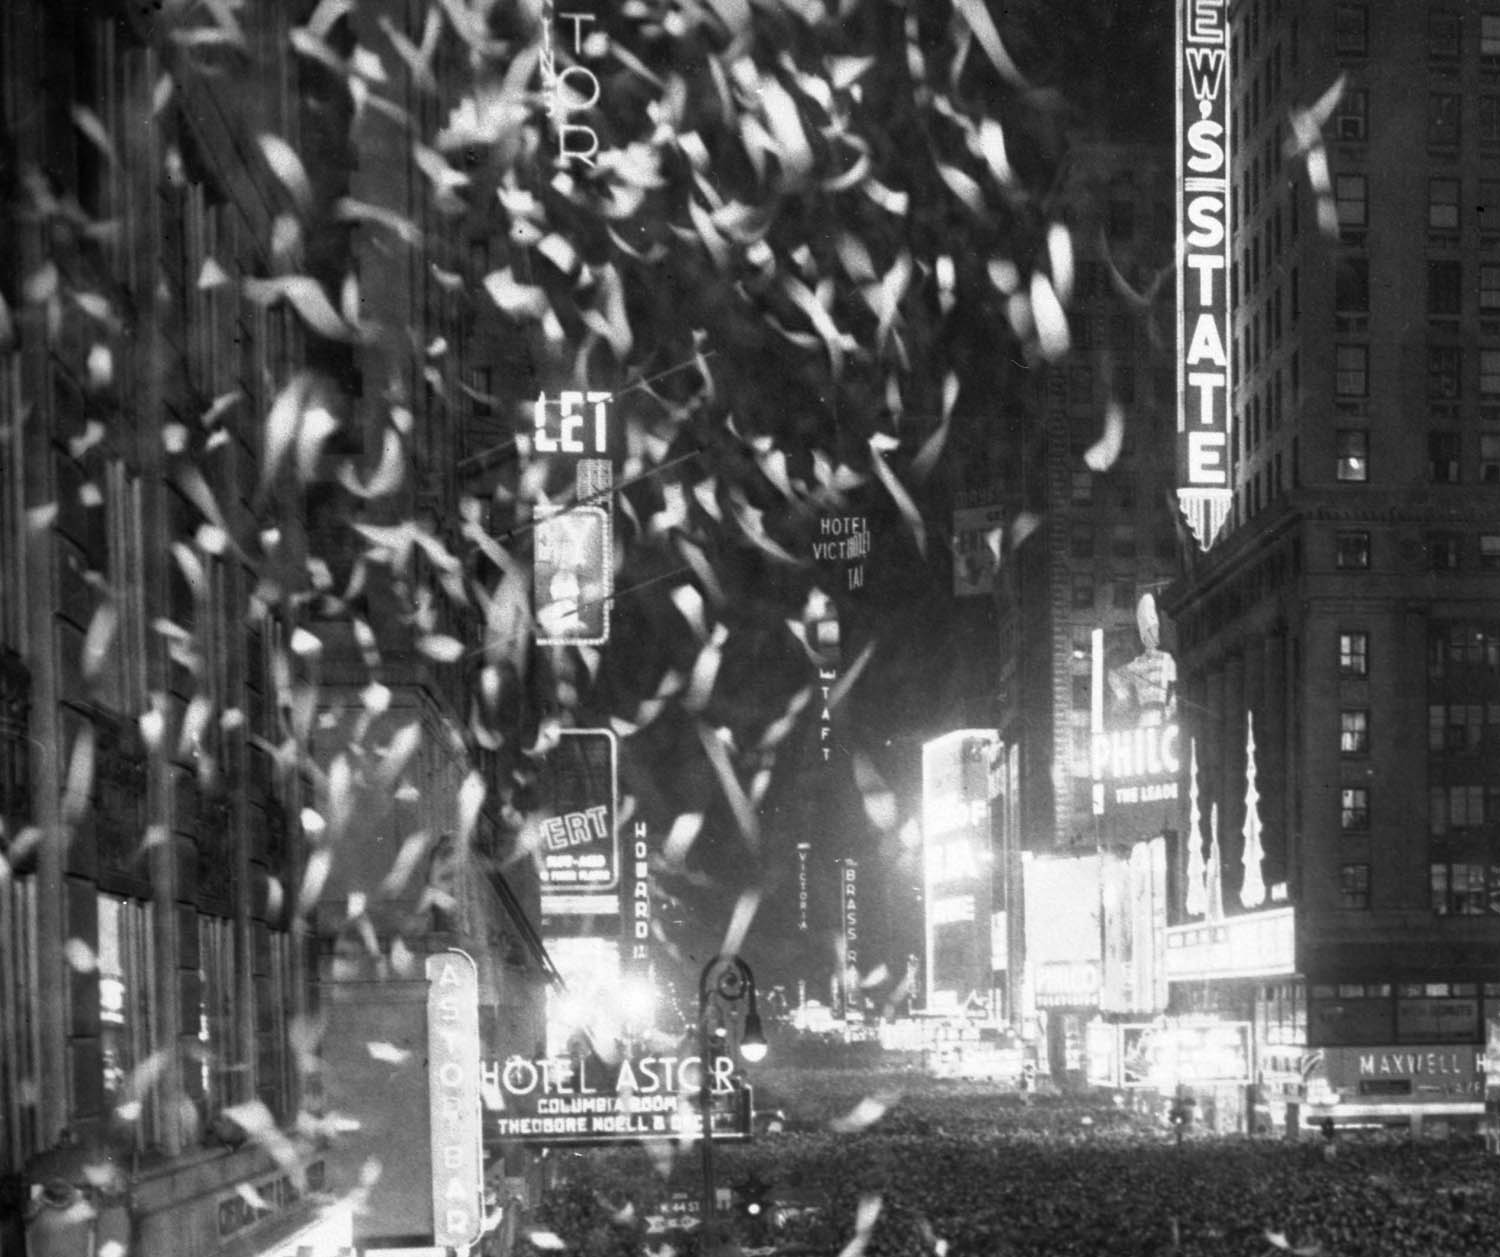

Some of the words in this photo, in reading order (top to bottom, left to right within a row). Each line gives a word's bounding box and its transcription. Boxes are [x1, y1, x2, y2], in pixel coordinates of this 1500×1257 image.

[1187, 196, 1227, 483] STATE
[535, 391, 610, 452] LET
[633, 822, 649, 938] HOWARD
[845, 869, 858, 940] BRASS
[480, 1055, 597, 1095] HOTEL
[1359, 1053, 1461, 1076] MAXWELL
